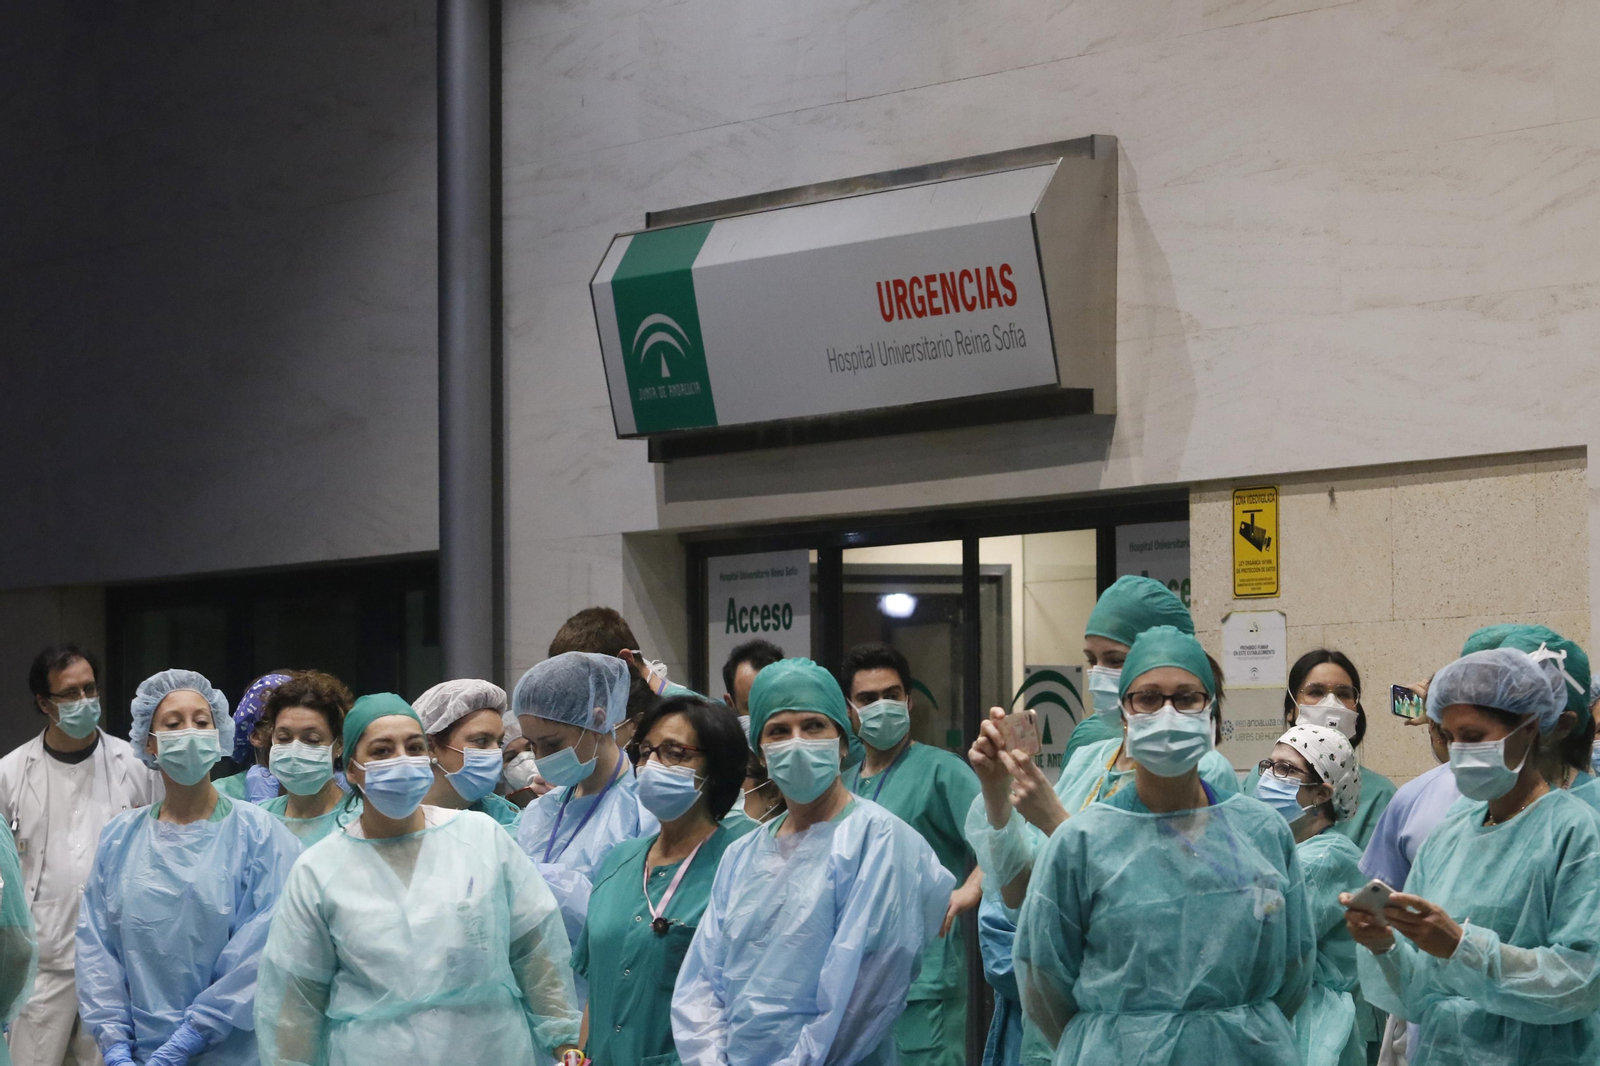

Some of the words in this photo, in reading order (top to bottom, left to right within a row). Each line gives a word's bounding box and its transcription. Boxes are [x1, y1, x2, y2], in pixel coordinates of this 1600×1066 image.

[876, 263, 1017, 322] URGENCIAS
[827, 343, 877, 375] Hospital
[877, 334, 953, 366] Universitario
[954, 329, 992, 357] Reina
[992, 322, 1027, 351] Sofía
[639, 387, 658, 400] JUNTA
[659, 385, 667, 398] DE
[1235, 495, 1247, 505] ZONA
[1129, 542, 1153, 554] Hospital
[771, 567, 785, 577] Reina
[725, 597, 793, 634] Acceso
[1035, 754, 1044, 768] DE
[1047, 753, 1064, 768] AND
